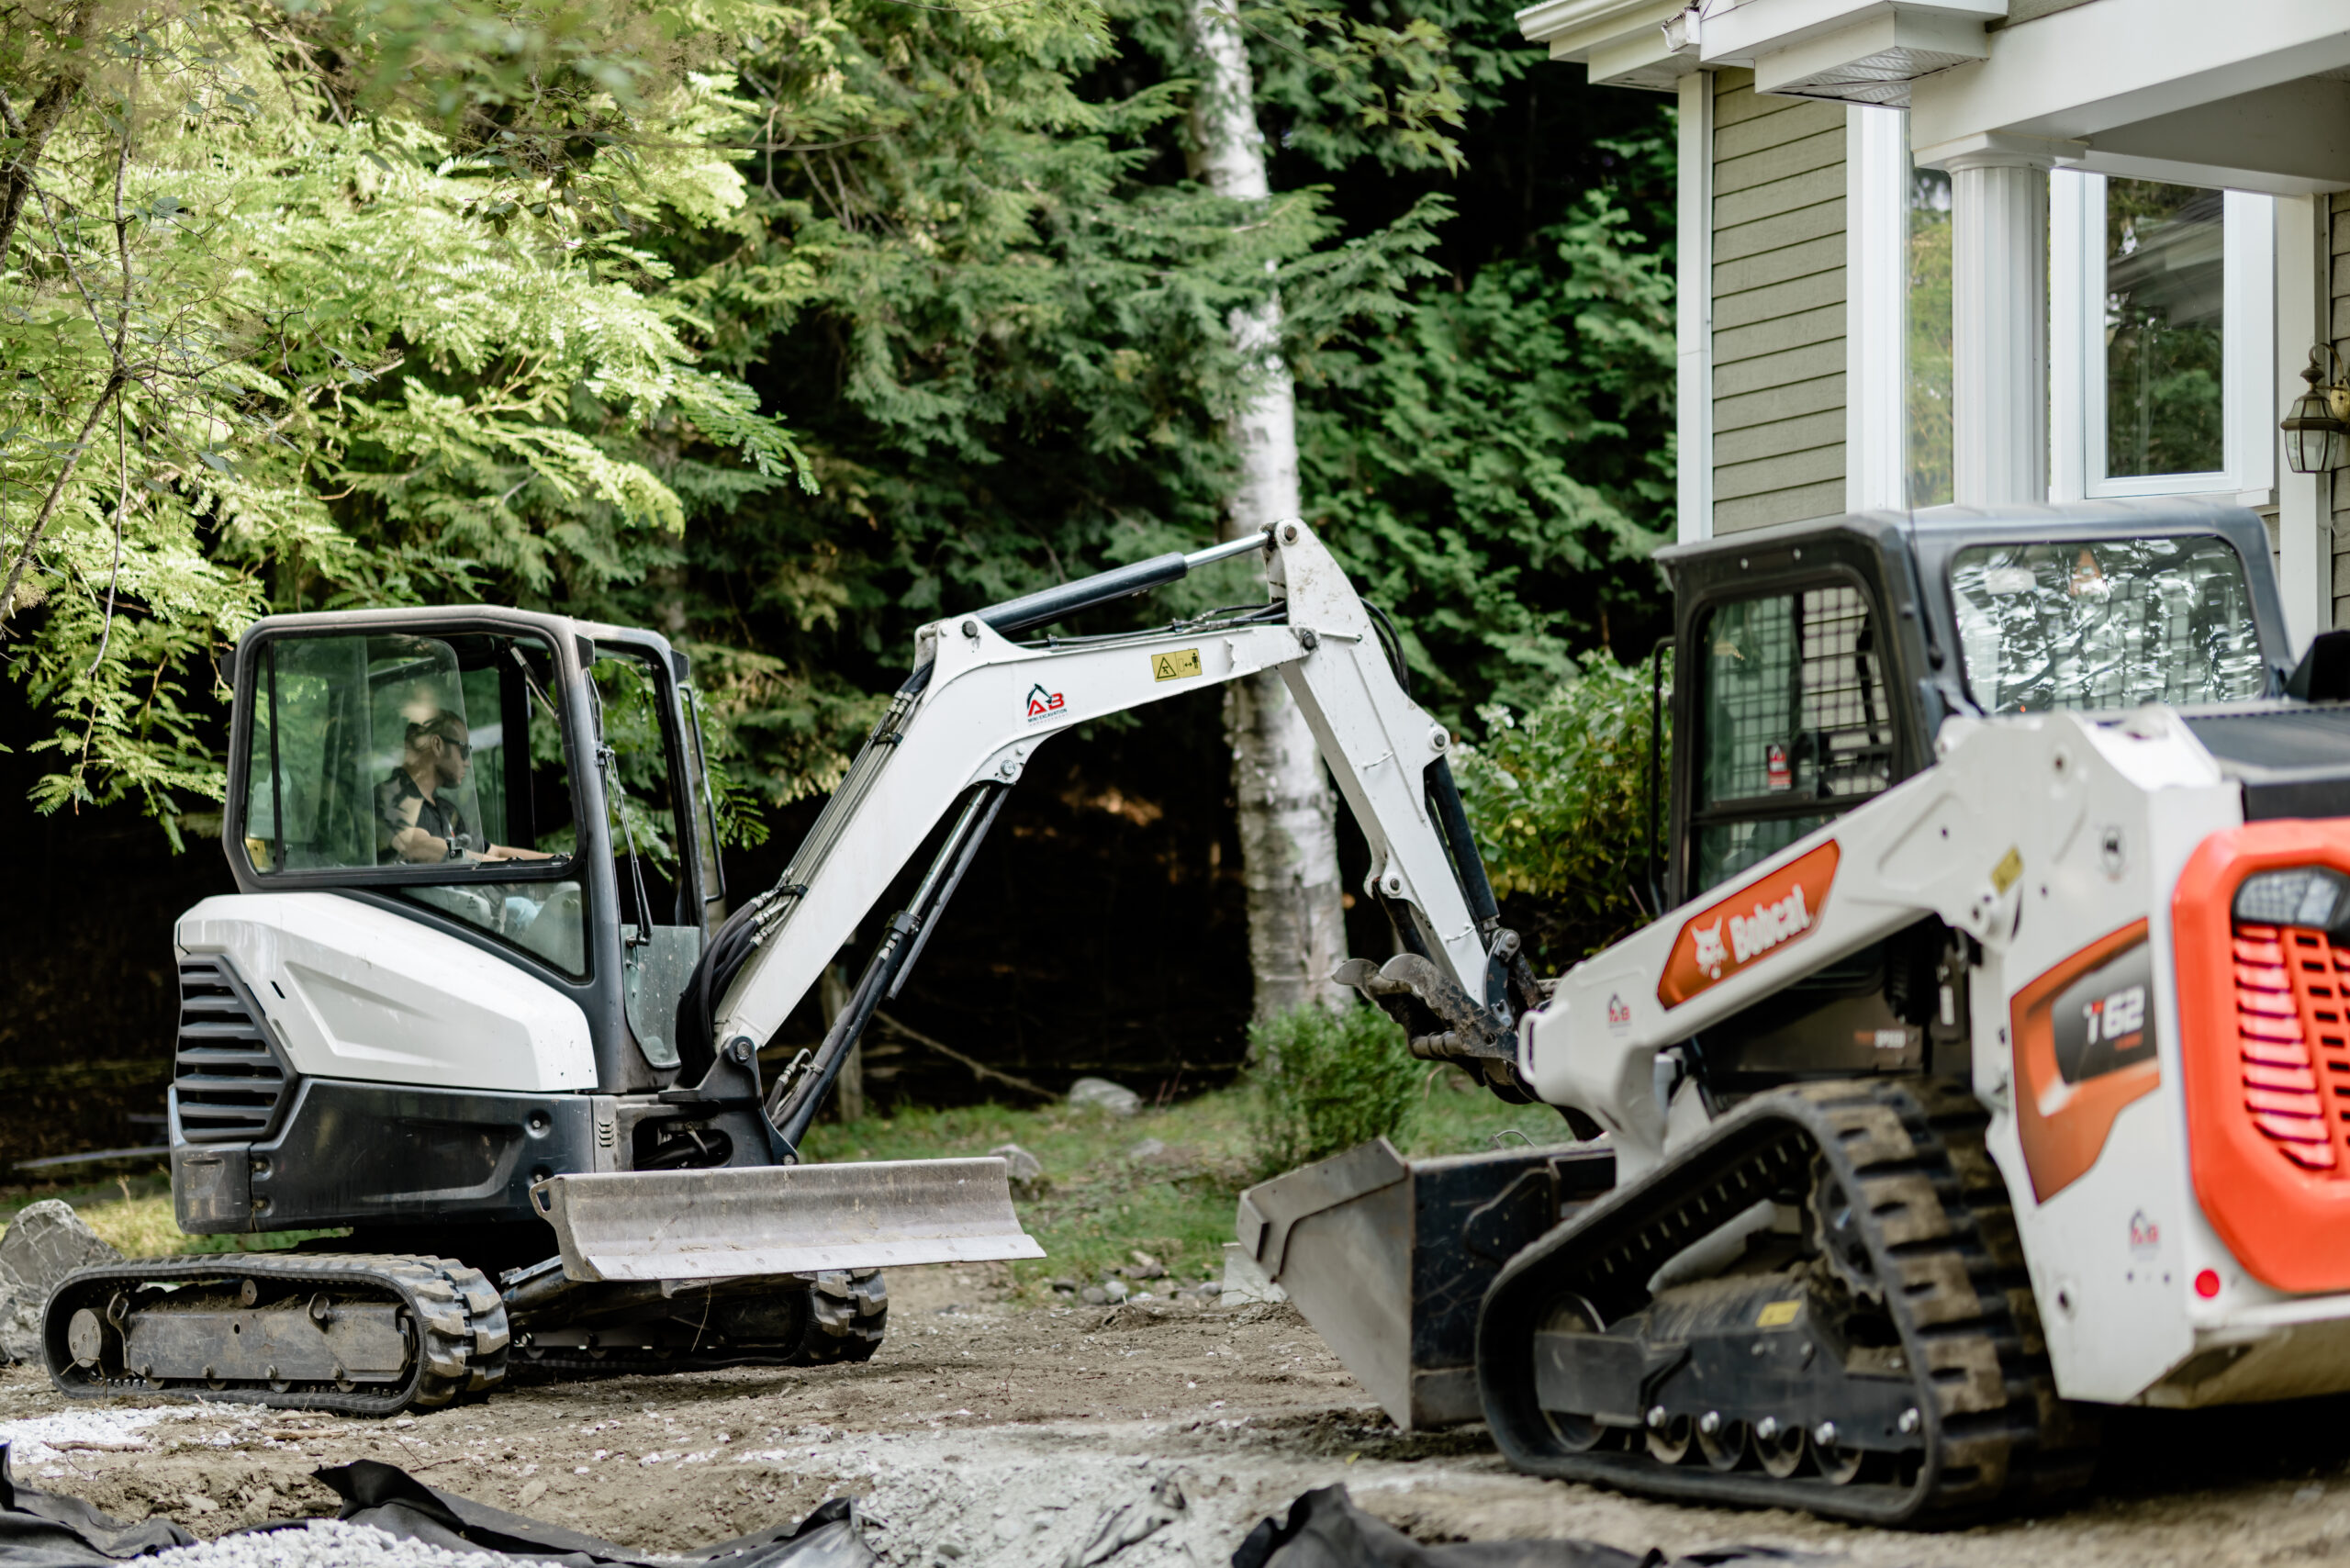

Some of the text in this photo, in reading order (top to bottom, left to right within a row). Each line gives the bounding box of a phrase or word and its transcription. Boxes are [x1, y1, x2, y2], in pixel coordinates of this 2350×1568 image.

[1028, 692, 1065, 717] AB
[1729, 884, 1809, 964] Bobcat
[2083, 986, 2145, 1045] T62
